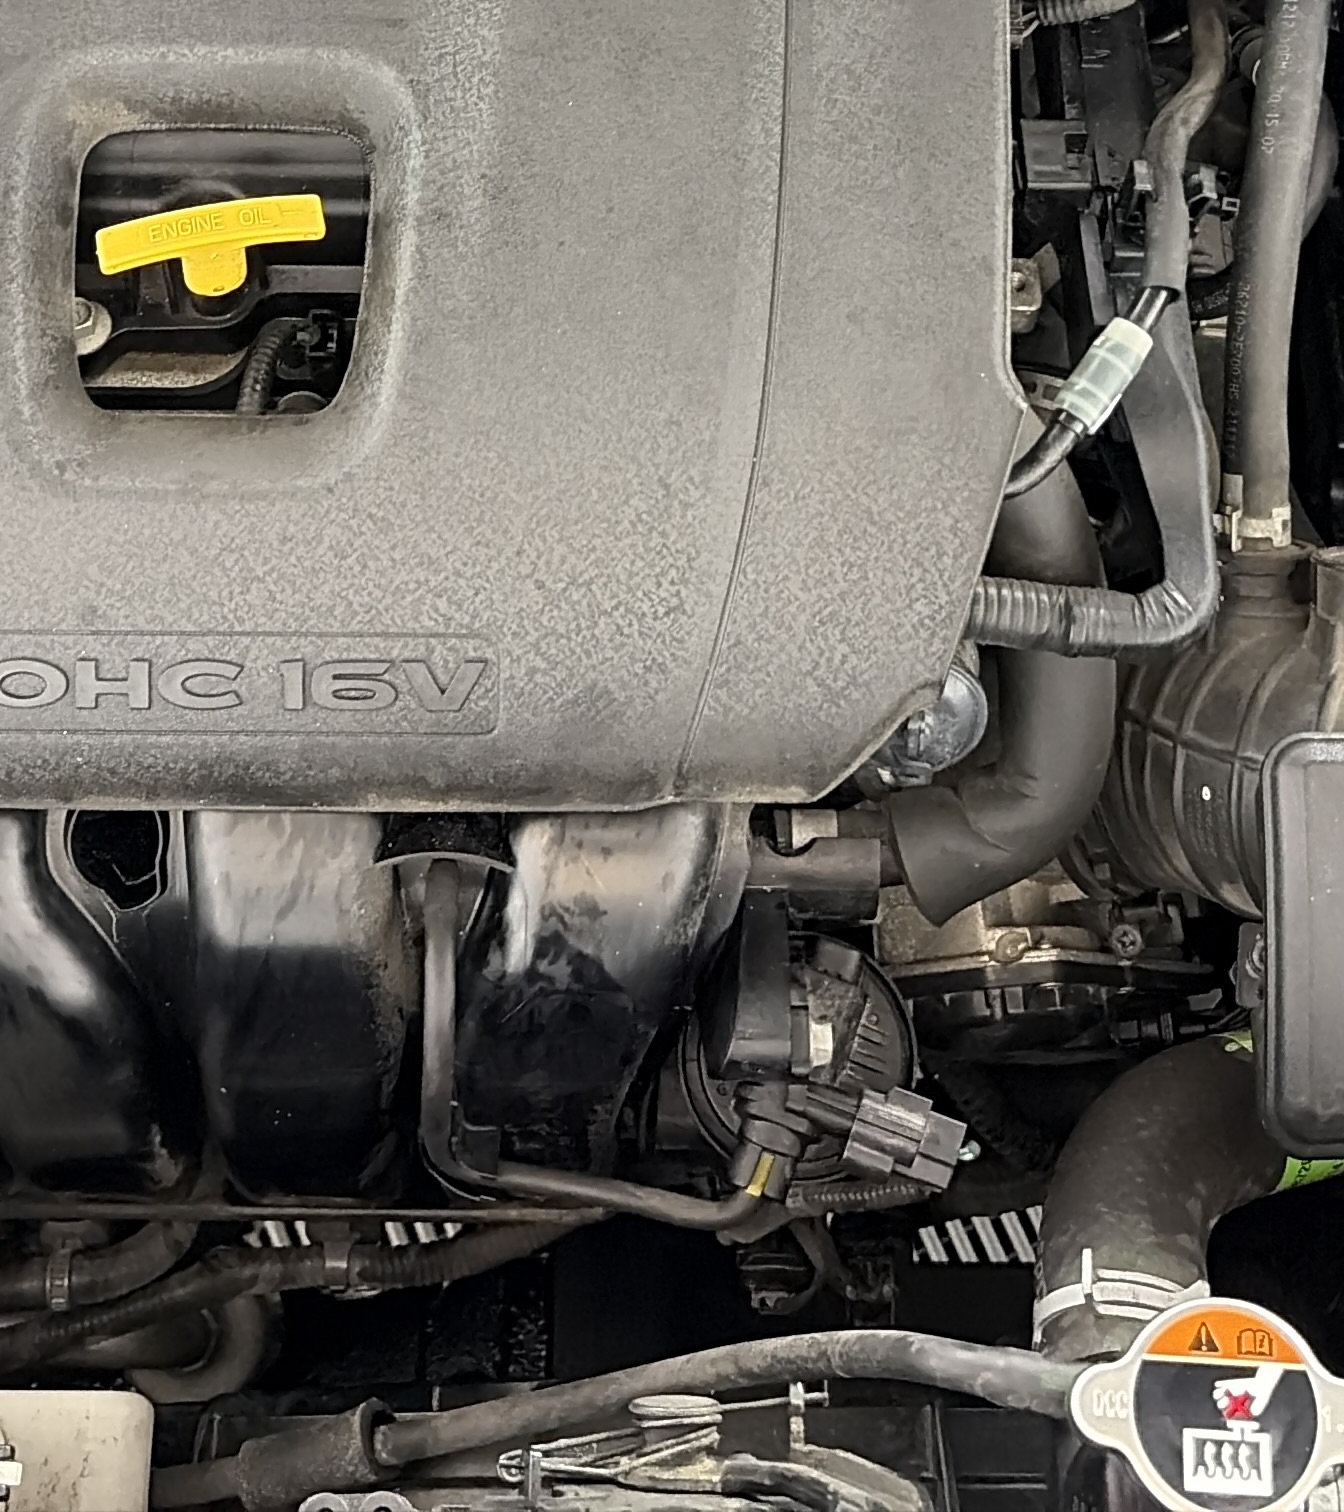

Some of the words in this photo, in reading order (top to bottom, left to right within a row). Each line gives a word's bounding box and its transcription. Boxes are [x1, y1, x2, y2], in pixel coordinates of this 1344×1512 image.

[147, 212, 225, 244] ENGINE
[238, 207, 272, 226] OIL
[278, 657, 489, 712] 16V
